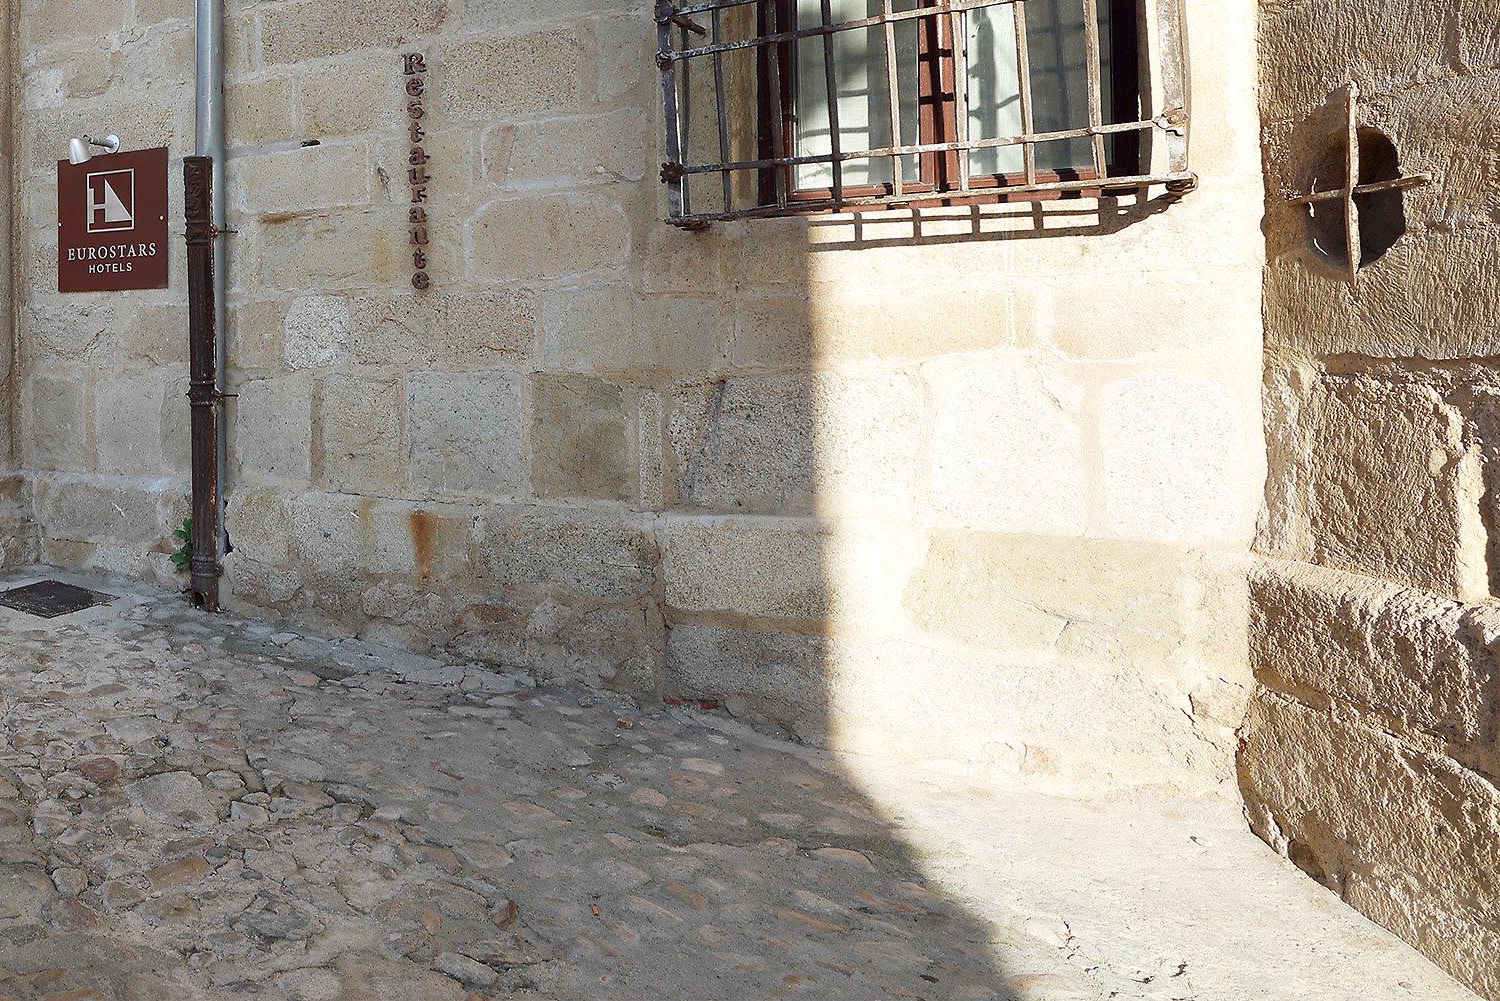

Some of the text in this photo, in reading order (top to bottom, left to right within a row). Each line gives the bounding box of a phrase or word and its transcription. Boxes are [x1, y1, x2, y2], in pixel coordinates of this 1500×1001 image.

[403, 52, 430, 290] Restaurante
[67, 242, 157, 261] EUROSTARS
[88, 262, 133, 274] HOTELS
